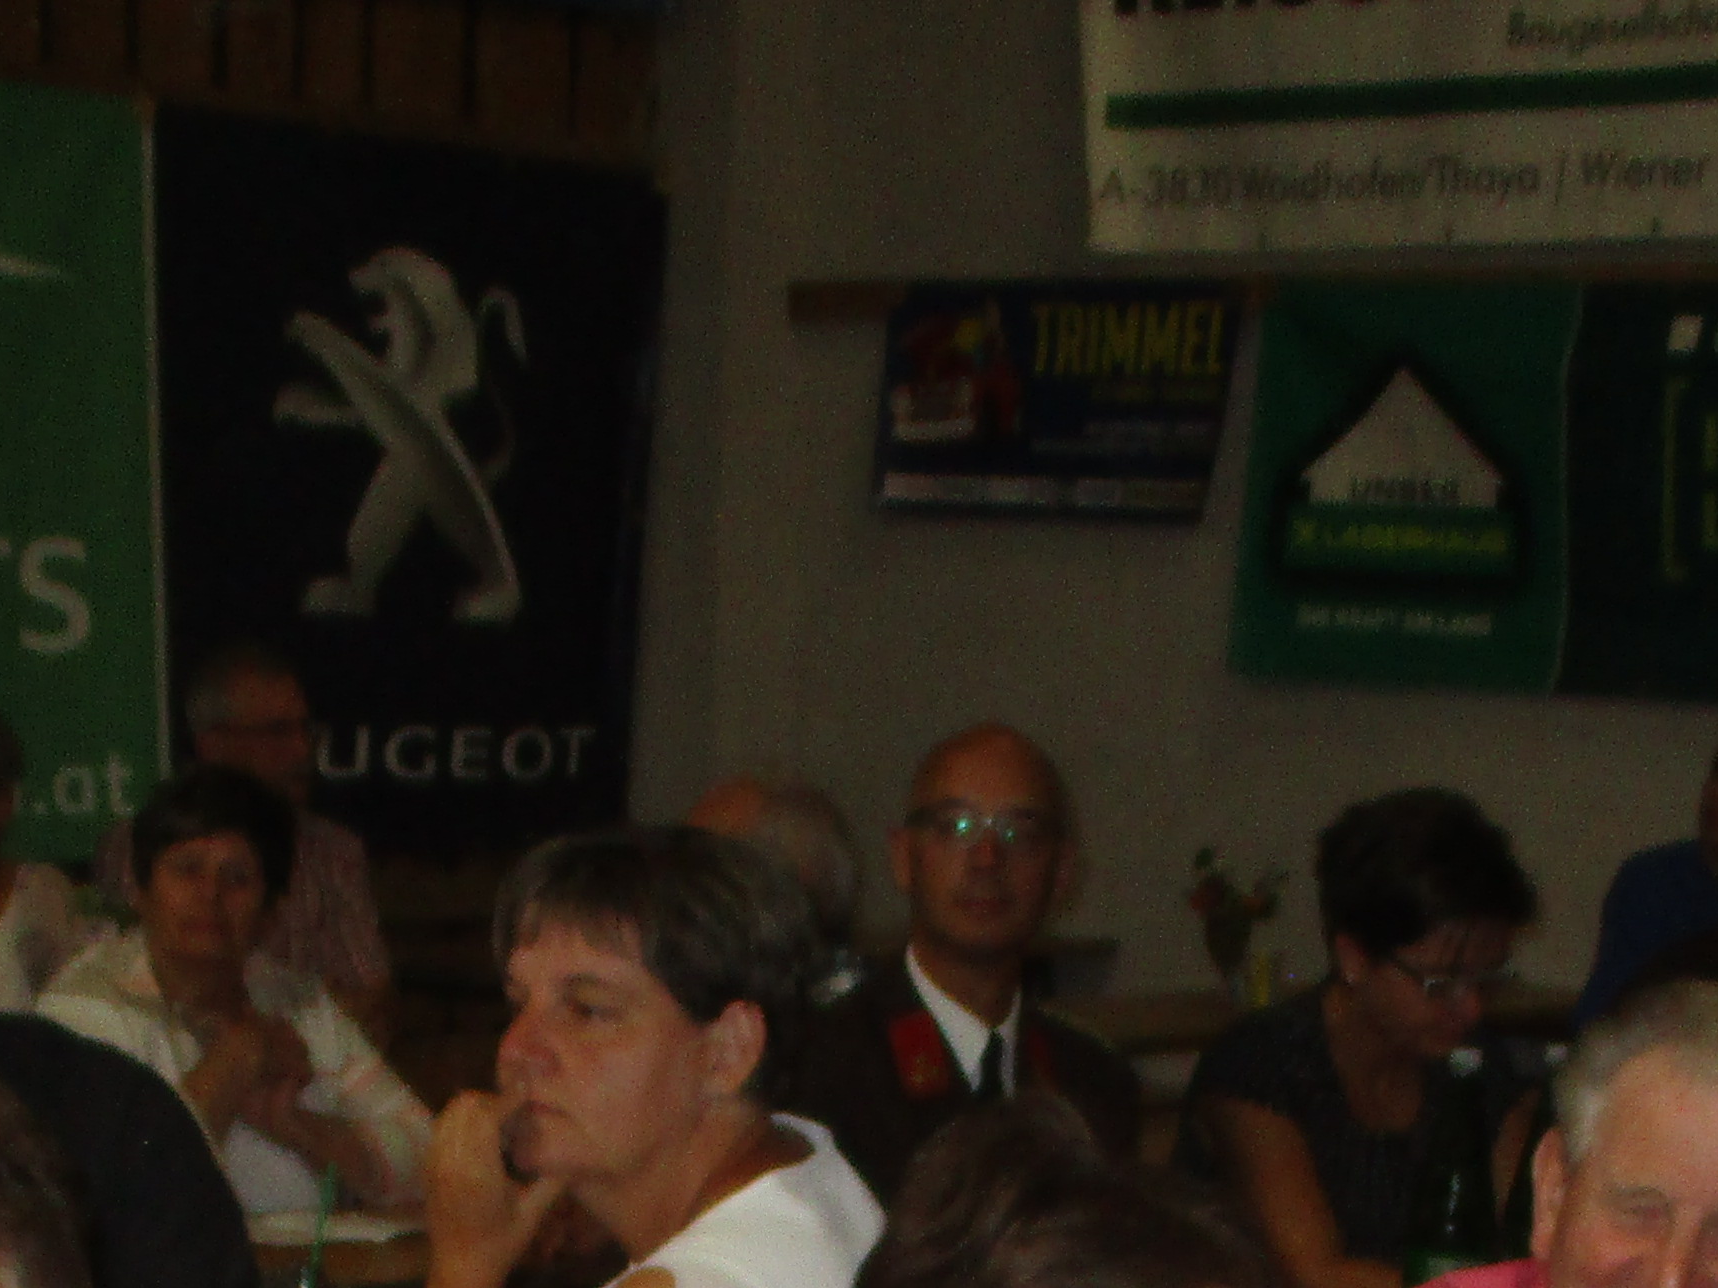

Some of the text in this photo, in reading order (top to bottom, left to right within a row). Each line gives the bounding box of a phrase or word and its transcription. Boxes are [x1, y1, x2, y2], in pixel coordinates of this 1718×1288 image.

[1580, 147, 1710, 191] Wiener
[1033, 302, 1222, 375] TRIMMEL
[315, 723, 596, 783] UGEOT
